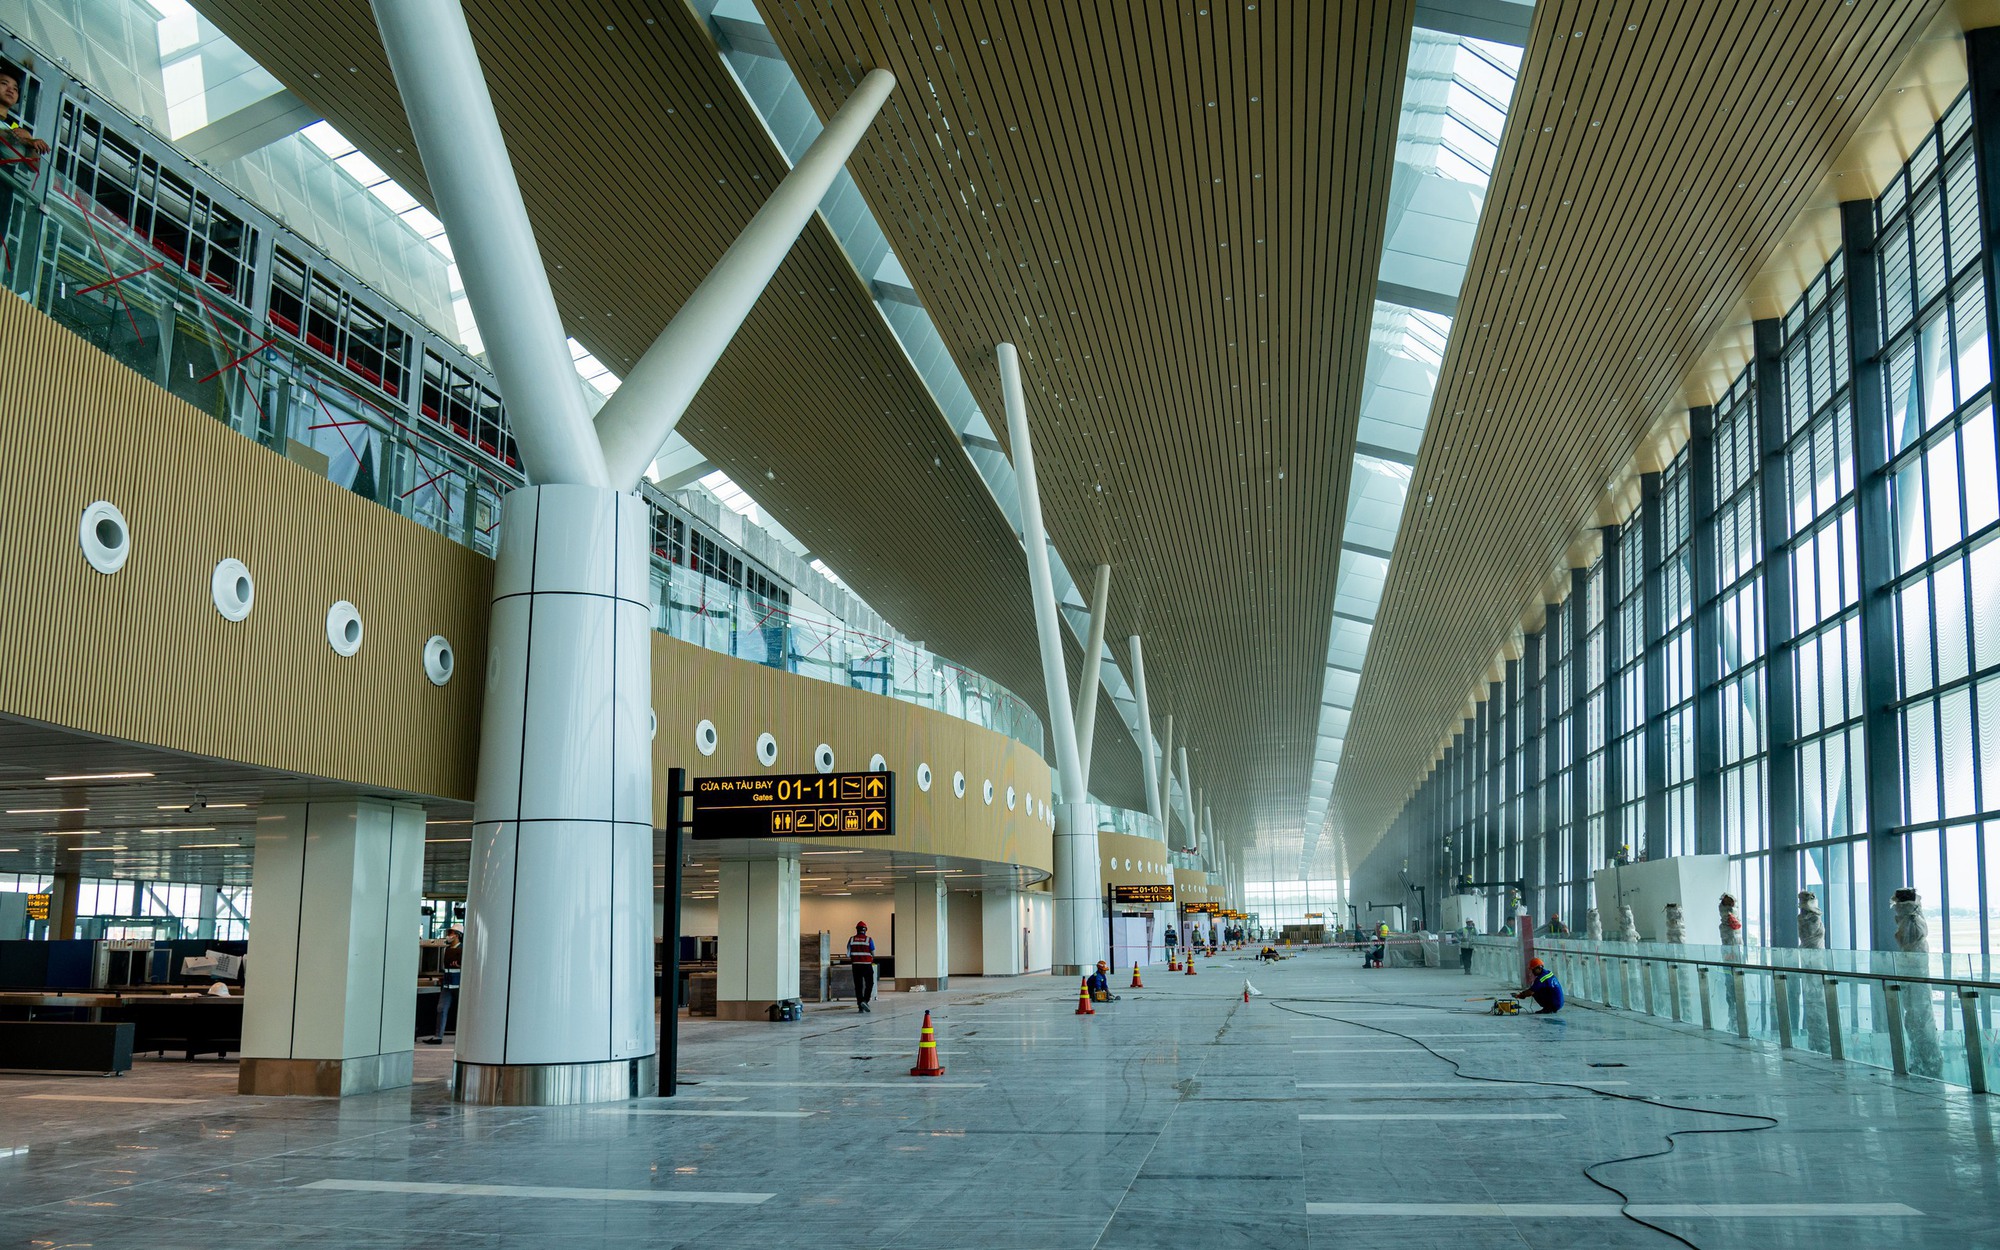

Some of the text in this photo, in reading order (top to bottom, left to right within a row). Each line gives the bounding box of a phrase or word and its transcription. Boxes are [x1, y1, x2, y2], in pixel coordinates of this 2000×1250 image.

[700, 780, 773, 791] CỬA RA TÀU BAY
[778, 779, 837, 800] 01-11
[753, 793, 773, 801] Gates
